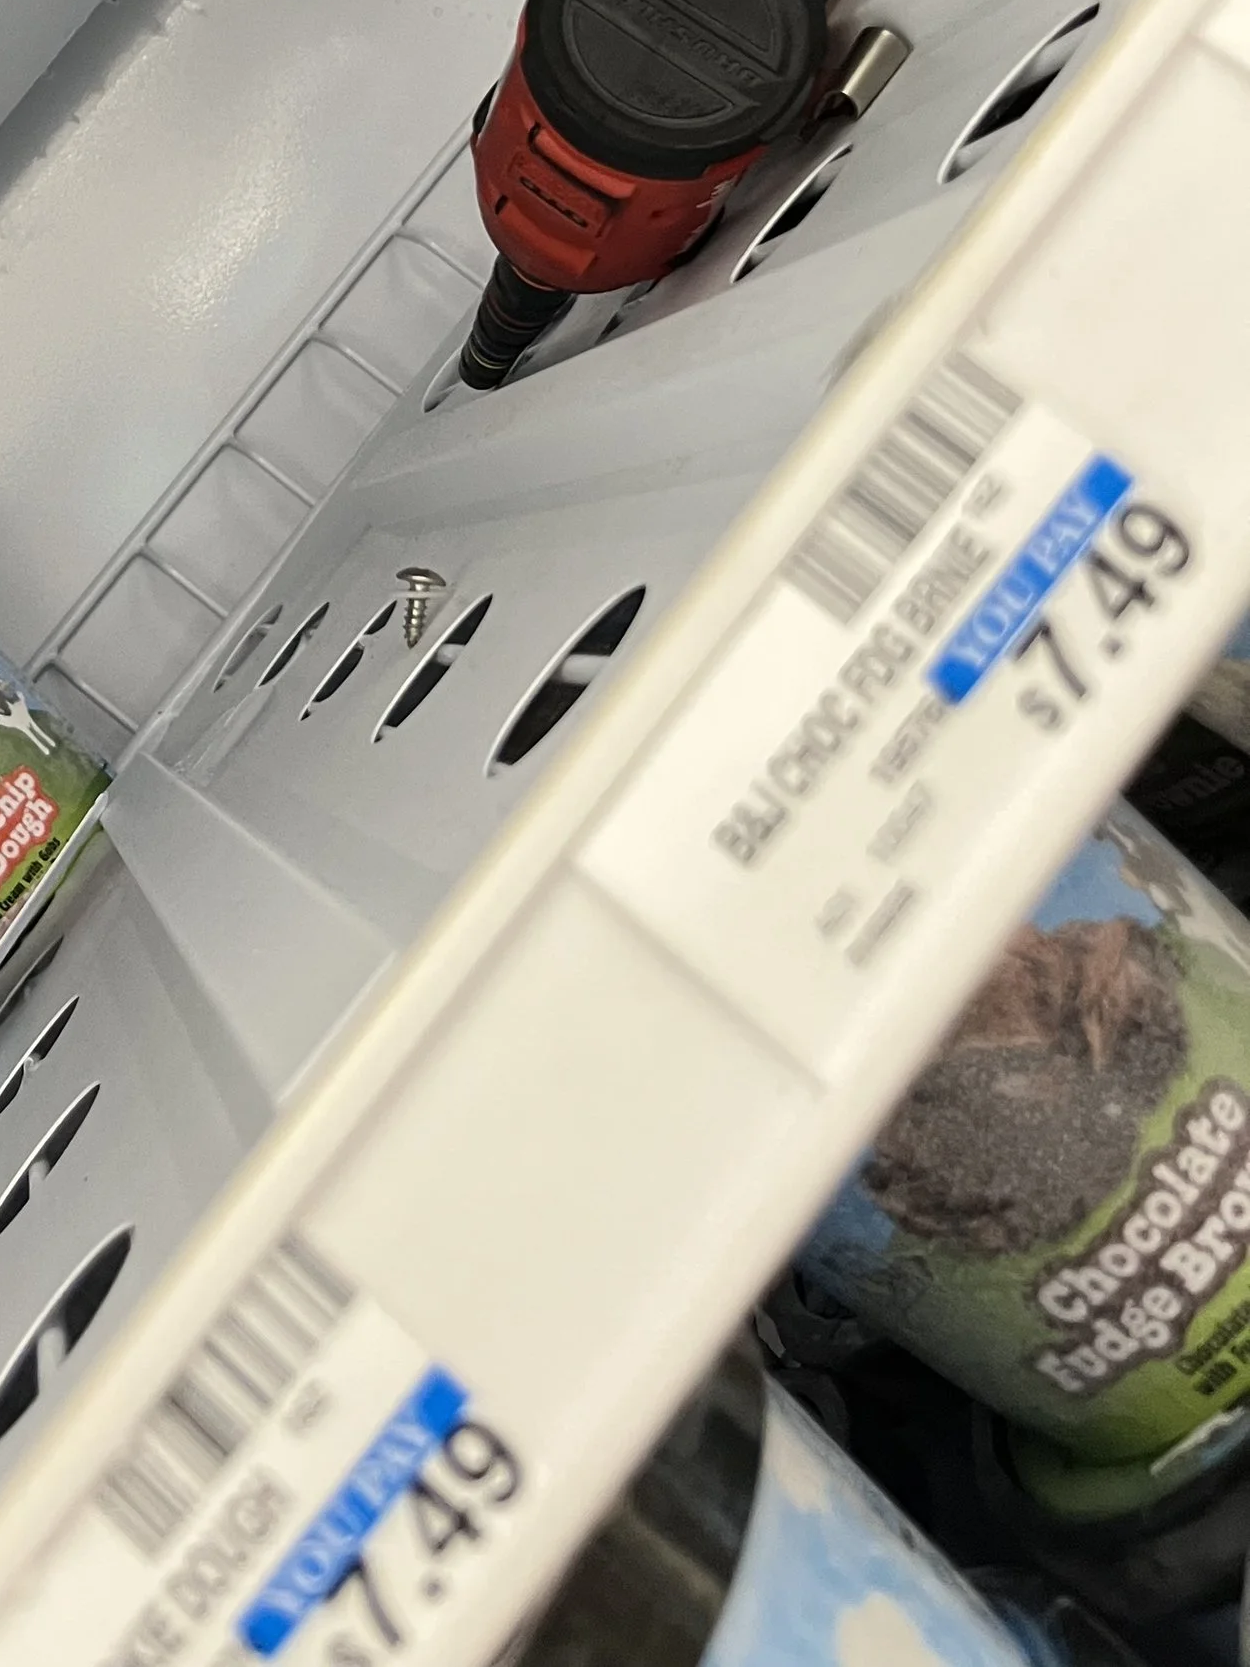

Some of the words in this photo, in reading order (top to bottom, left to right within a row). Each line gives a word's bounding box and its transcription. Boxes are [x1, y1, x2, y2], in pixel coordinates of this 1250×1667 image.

[957, 571, 1035, 669] YOU
[1034, 494, 1097, 574] PAY
[1017, 502, 1191, 730] $7.49
[767, 689, 860, 795] CHOC
[839, 624, 914, 700] FDG
[22, 860, 44, 883] with
[1038, 1092, 1246, 1322] Chocolate
[1035, 1286, 1183, 1393] Fudge
